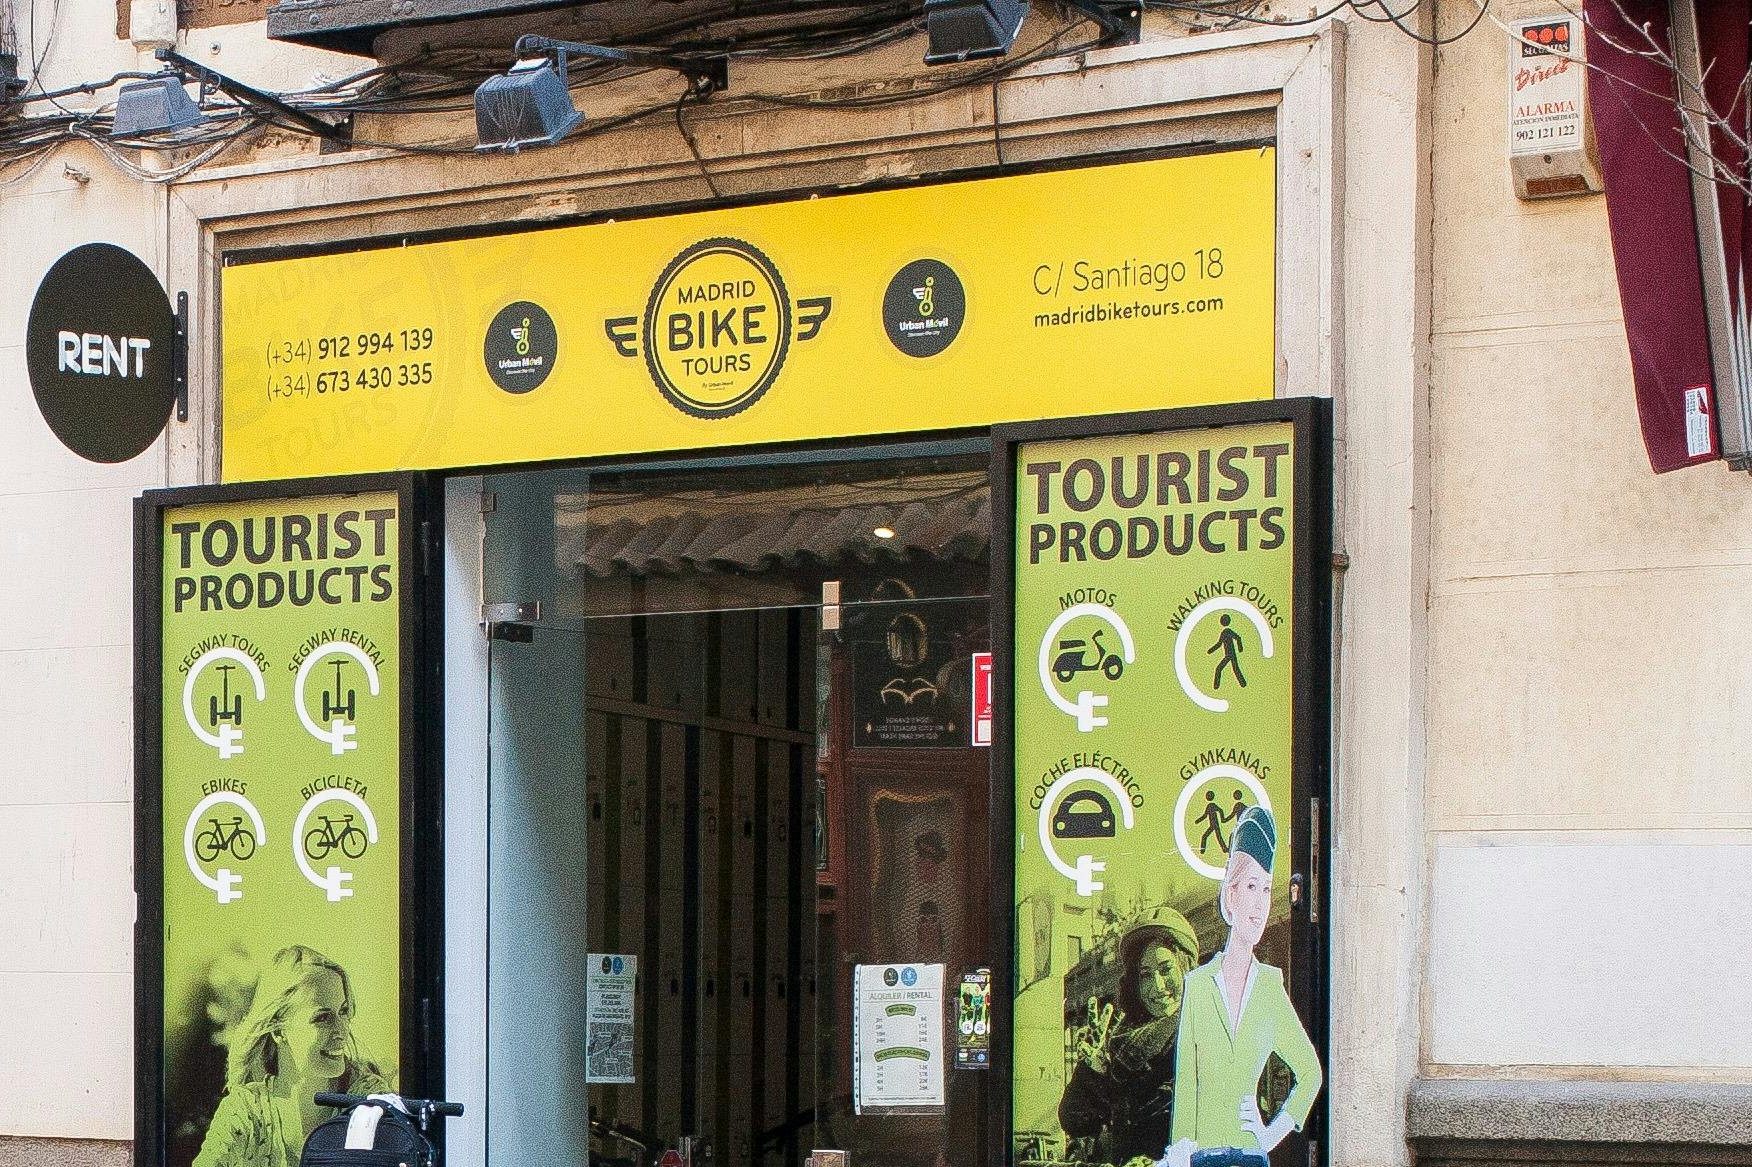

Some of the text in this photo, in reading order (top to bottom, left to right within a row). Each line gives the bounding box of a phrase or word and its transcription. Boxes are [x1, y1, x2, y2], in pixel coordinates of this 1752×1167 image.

[1516, 100, 1575, 117] ALARMA
[1516, 125, 1575, 141] 902 121 122
[1033, 247, 1224, 298] C/ Santiago 18
[678, 280, 756, 306] MADRID
[1034, 295, 1224, 328] madridbiketours.com
[669, 305, 767, 352] BIKE
[899, 321, 924, 331] Urban
[57, 330, 151, 379] RENT
[266, 327, 434, 369] (+34) 912 994 139
[499, 358, 521, 369] Urban
[682, 353, 751, 378] TOURS
[266, 362, 433, 402] (+34) 673 430 335
[1026, 442, 1289, 515] TOURIST
[171, 508, 396, 569] TOURIST
[1029, 506, 1286, 565] PRODUCTS
[173, 564, 392, 613] PRODUCTS
[1059, 587, 1117, 609] MOTOS
[1167, 579, 1284, 633] WALKING TOURS
[179, 634, 270, 676] SEGWAY TOURS
[288, 629, 385, 673] SEGWAY RENTAL
[1029, 750, 1145, 810] COCHE ELÉCTRICO
[1179, 747, 1271, 781] GYMKANAS
[202, 778, 247, 796] EBIKES
[301, 775, 368, 801] BICICLETA
[907, 991, 933, 999] RENTAL
